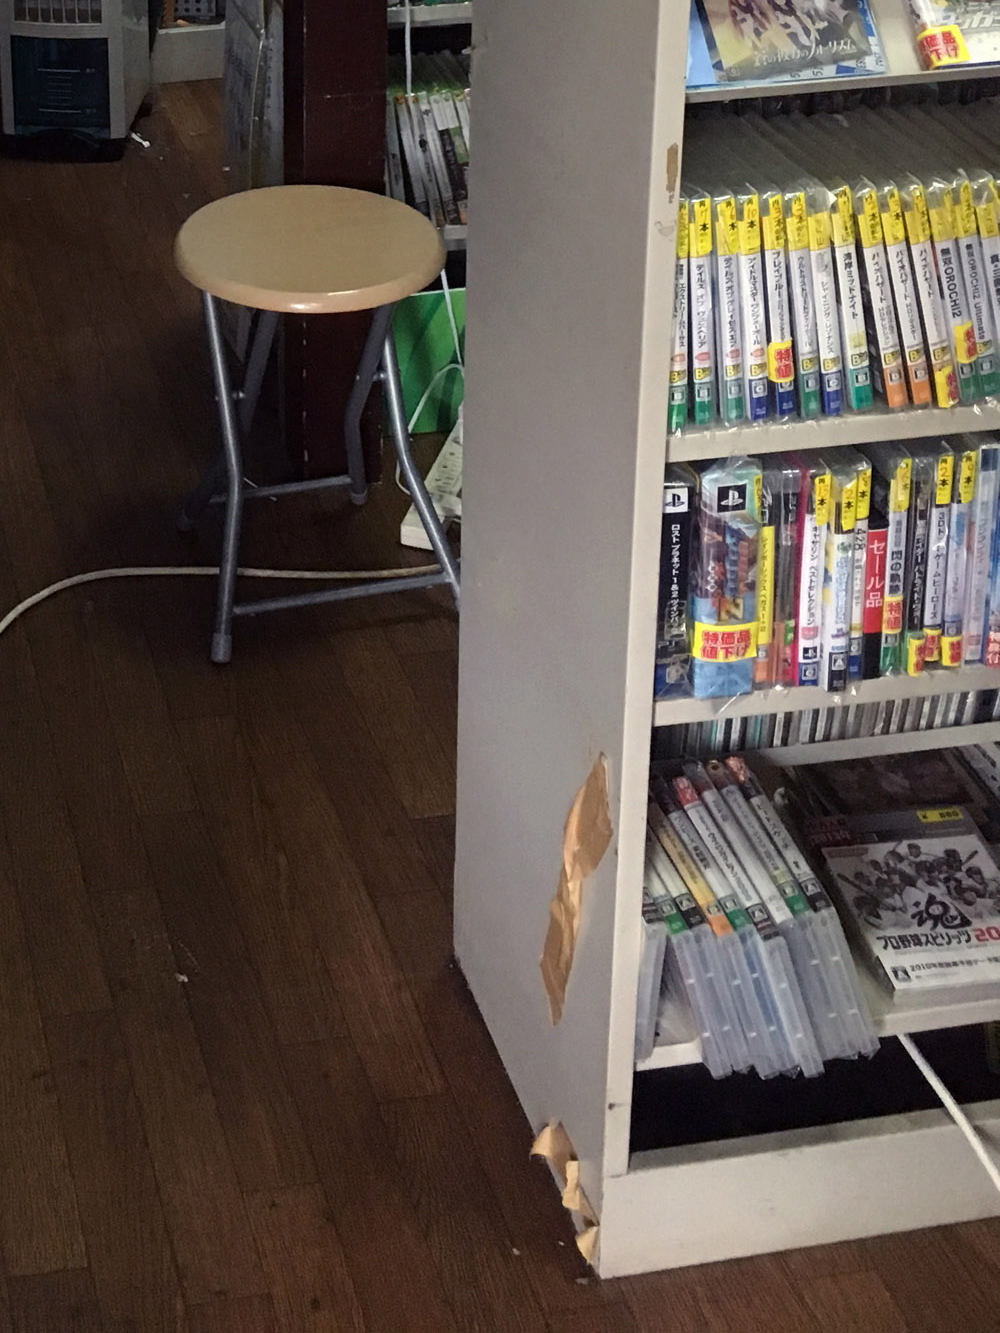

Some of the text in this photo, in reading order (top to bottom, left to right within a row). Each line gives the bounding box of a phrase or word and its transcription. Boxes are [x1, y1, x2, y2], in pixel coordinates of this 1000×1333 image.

[973, 301, 985, 341] Ultimate
[866, 540, 887, 608] セール品
[702, 629, 752, 646] 特価品
[702, 645, 751, 660] 値下げ
[876, 929, 972, 950] プロ野球スピリッツ
